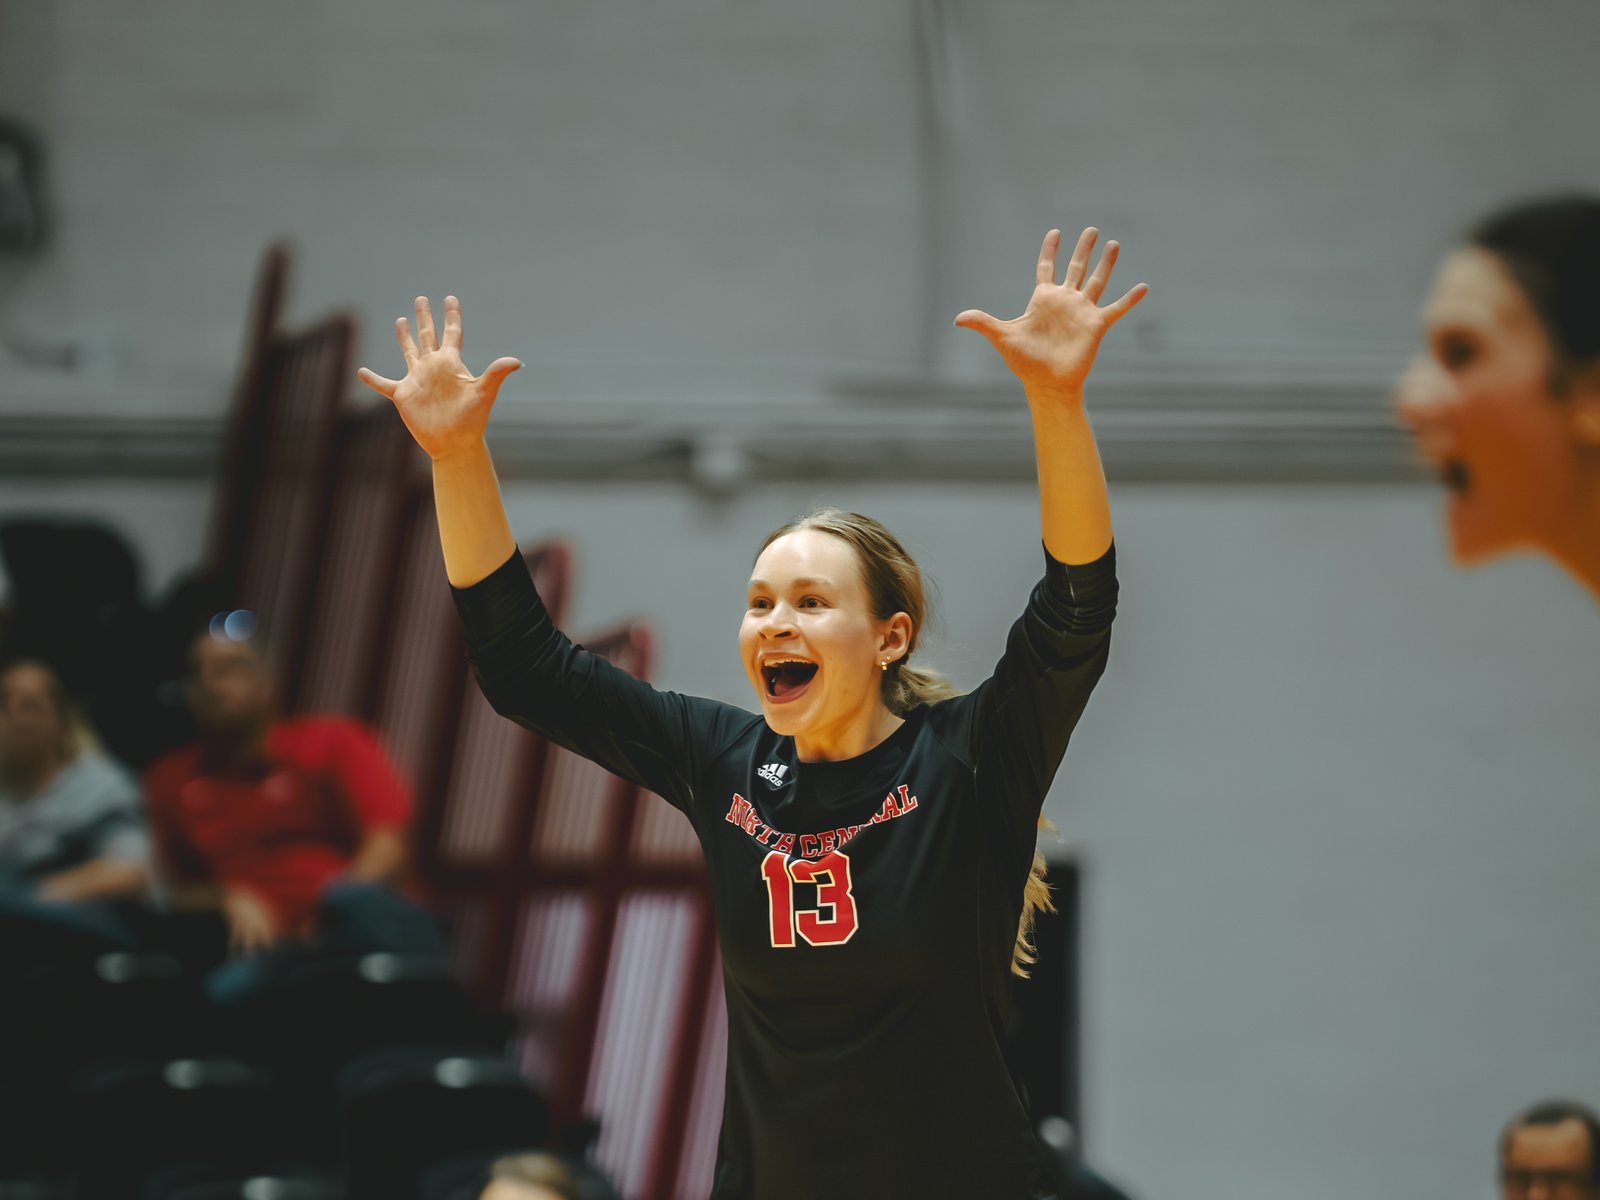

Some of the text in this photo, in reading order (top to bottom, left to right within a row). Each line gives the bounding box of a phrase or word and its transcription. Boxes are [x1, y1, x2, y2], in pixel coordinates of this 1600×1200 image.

[756, 766, 783, 787] didas
[800, 784, 918, 858] CENAL
[761, 850, 859, 948] 13
